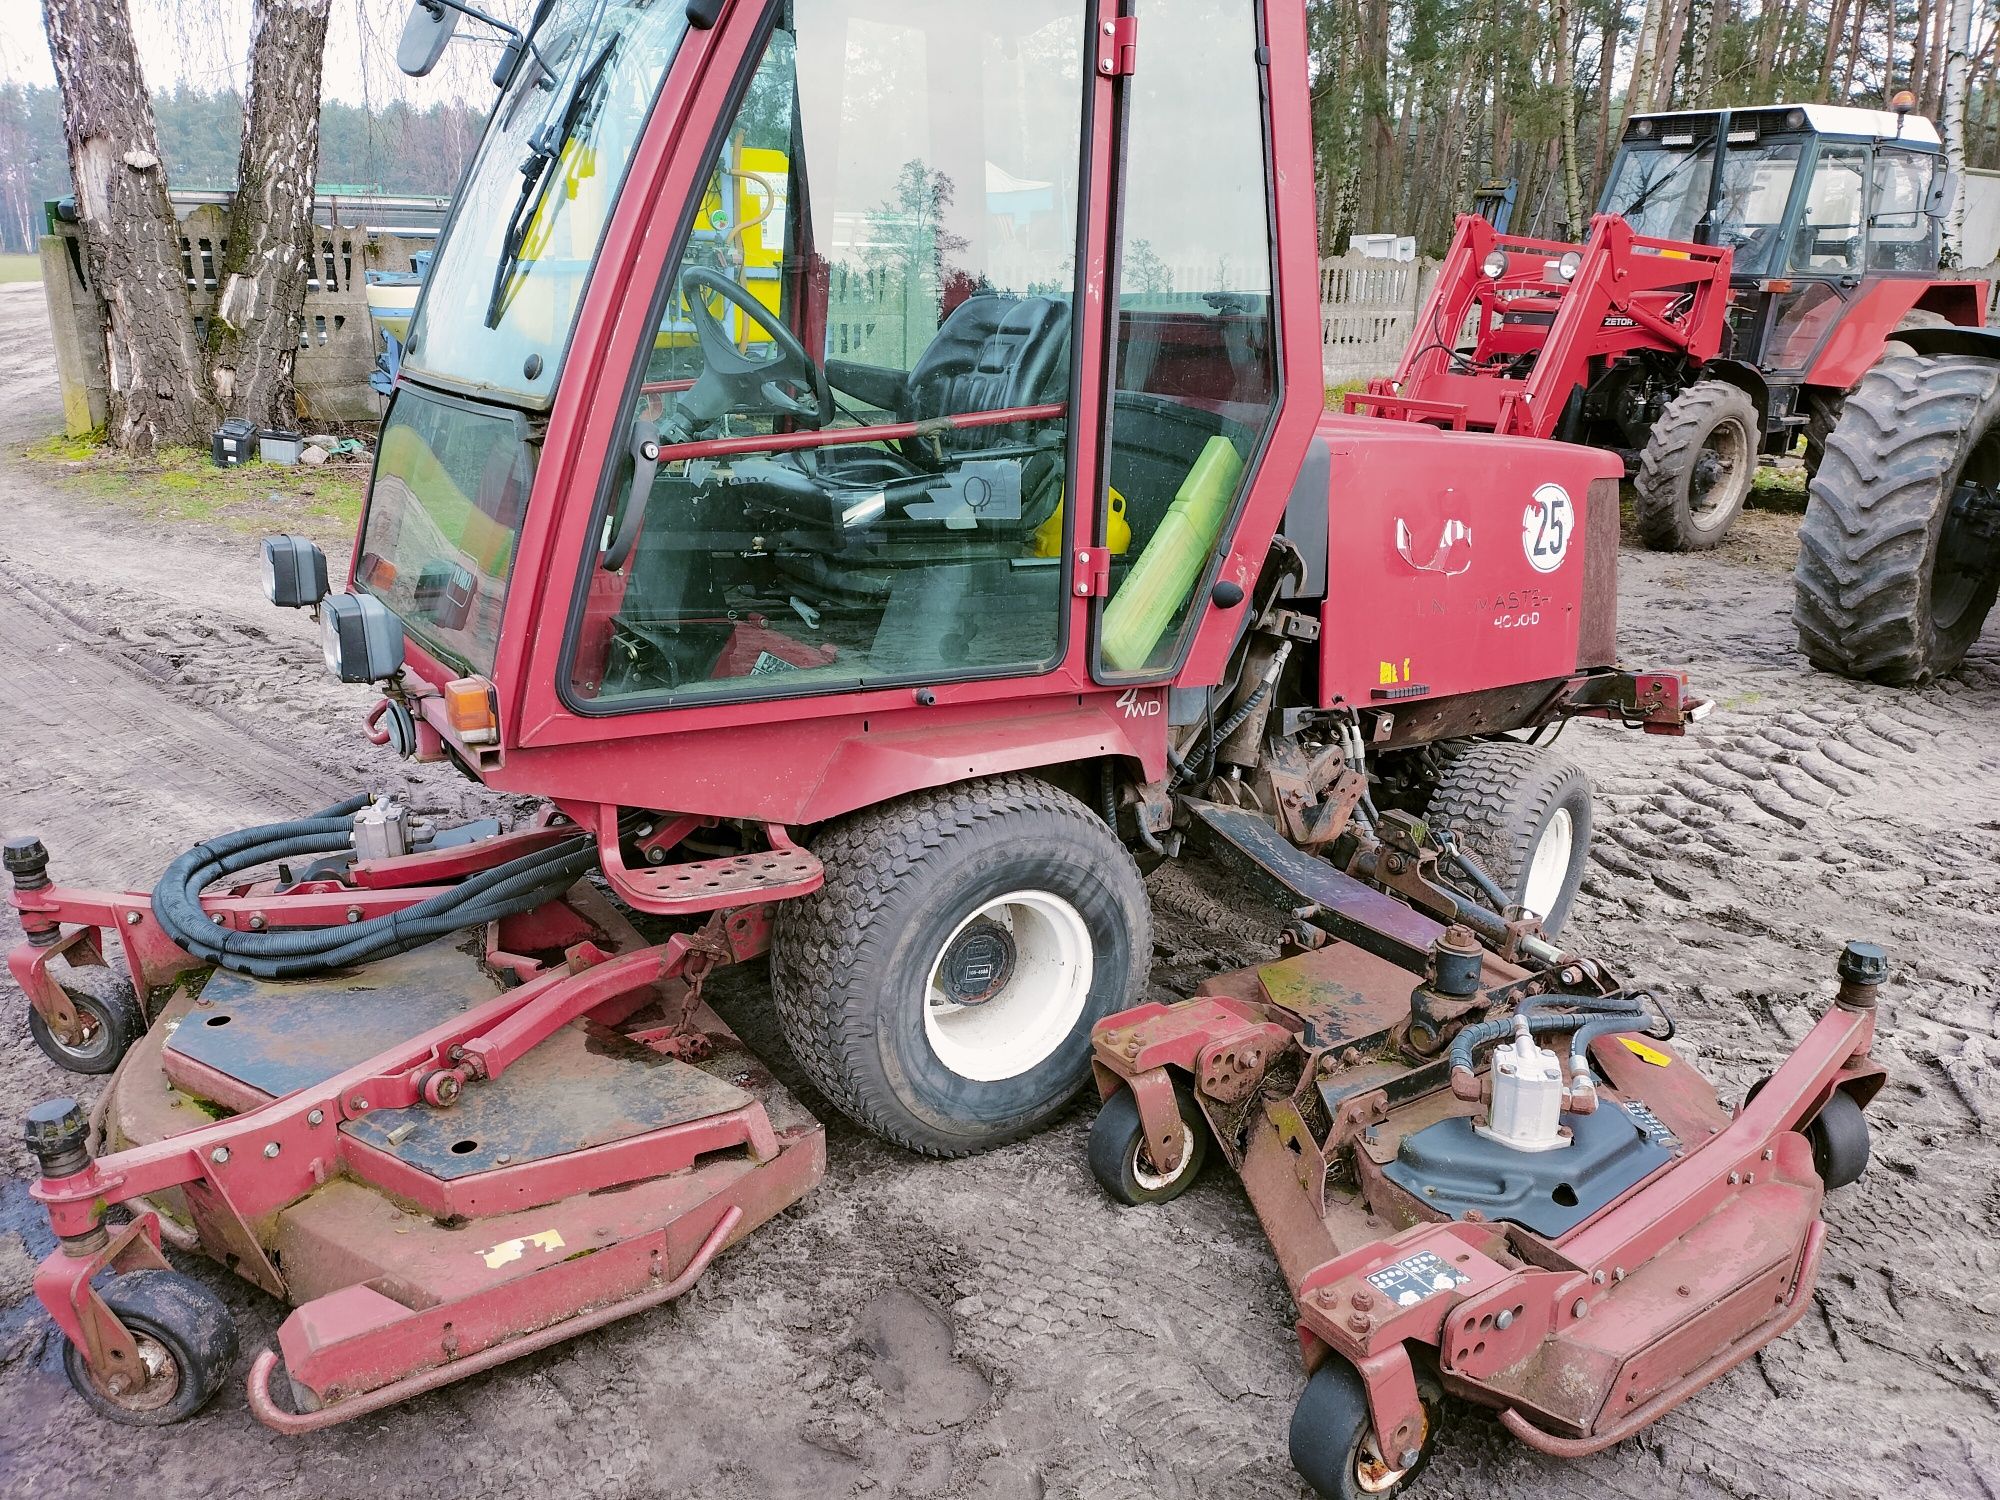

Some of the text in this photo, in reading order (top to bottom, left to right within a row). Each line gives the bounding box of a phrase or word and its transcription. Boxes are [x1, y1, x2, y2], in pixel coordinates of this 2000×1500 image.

[1605, 317, 1633, 326] ZETOR
[1533, 500, 1564, 556] 25
[1116, 687, 1161, 719] 4WD
